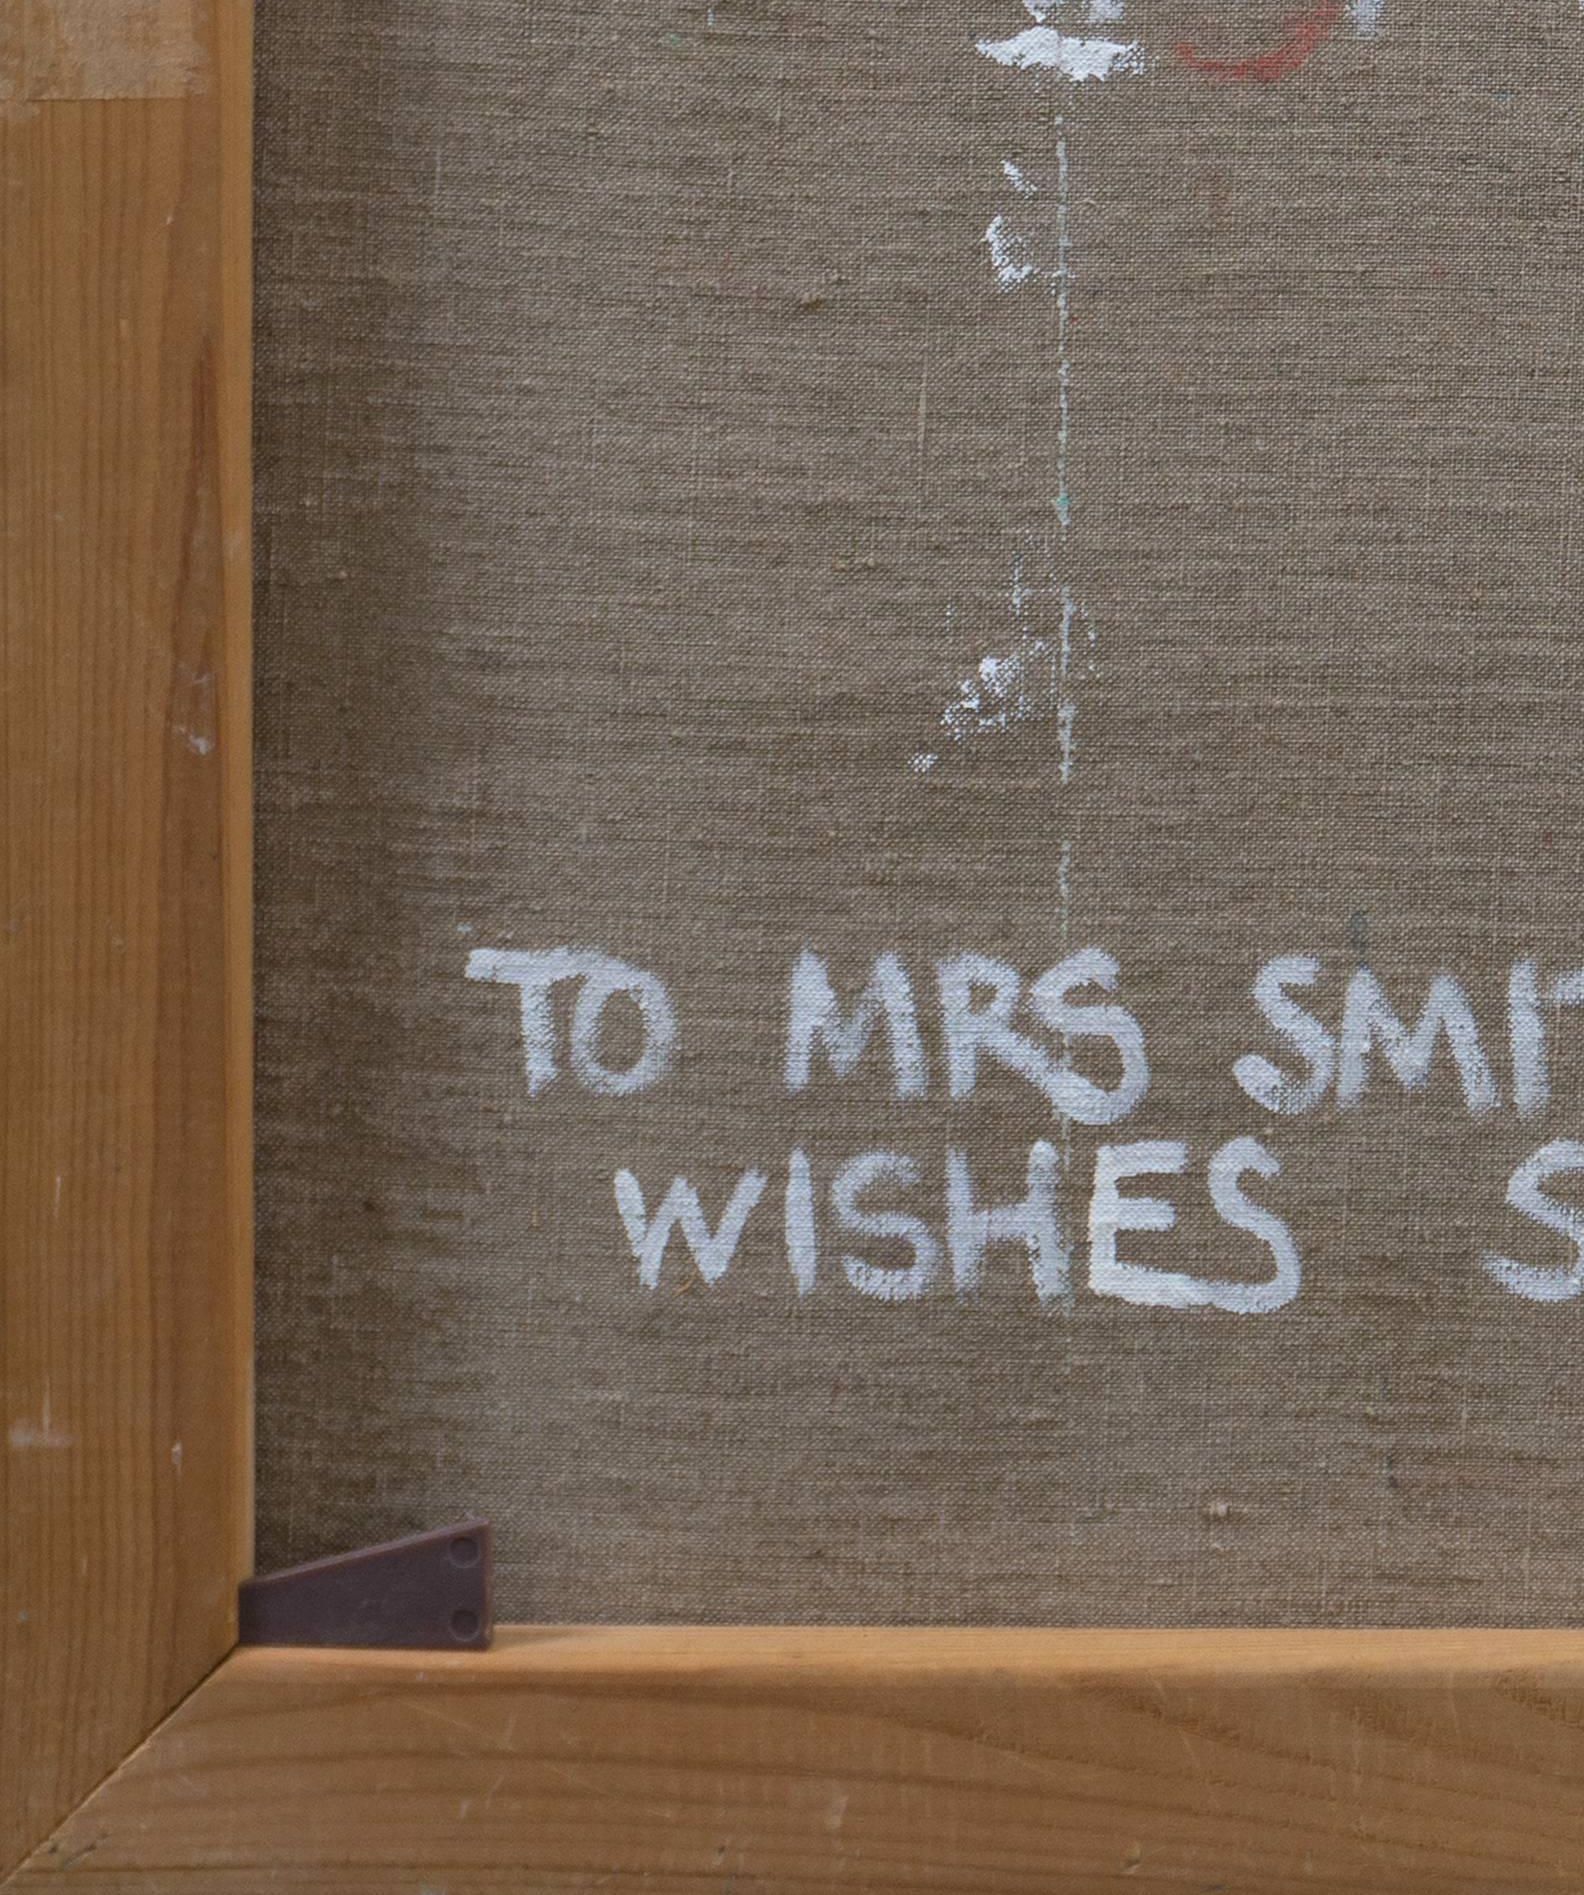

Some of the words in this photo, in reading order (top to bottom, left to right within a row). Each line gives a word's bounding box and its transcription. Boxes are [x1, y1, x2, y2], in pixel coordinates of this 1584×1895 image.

[466, 947, 674, 1093] TO
[786, 946, 1146, 1123] MRS
[614, 1137, 1298, 1313] WISHES
